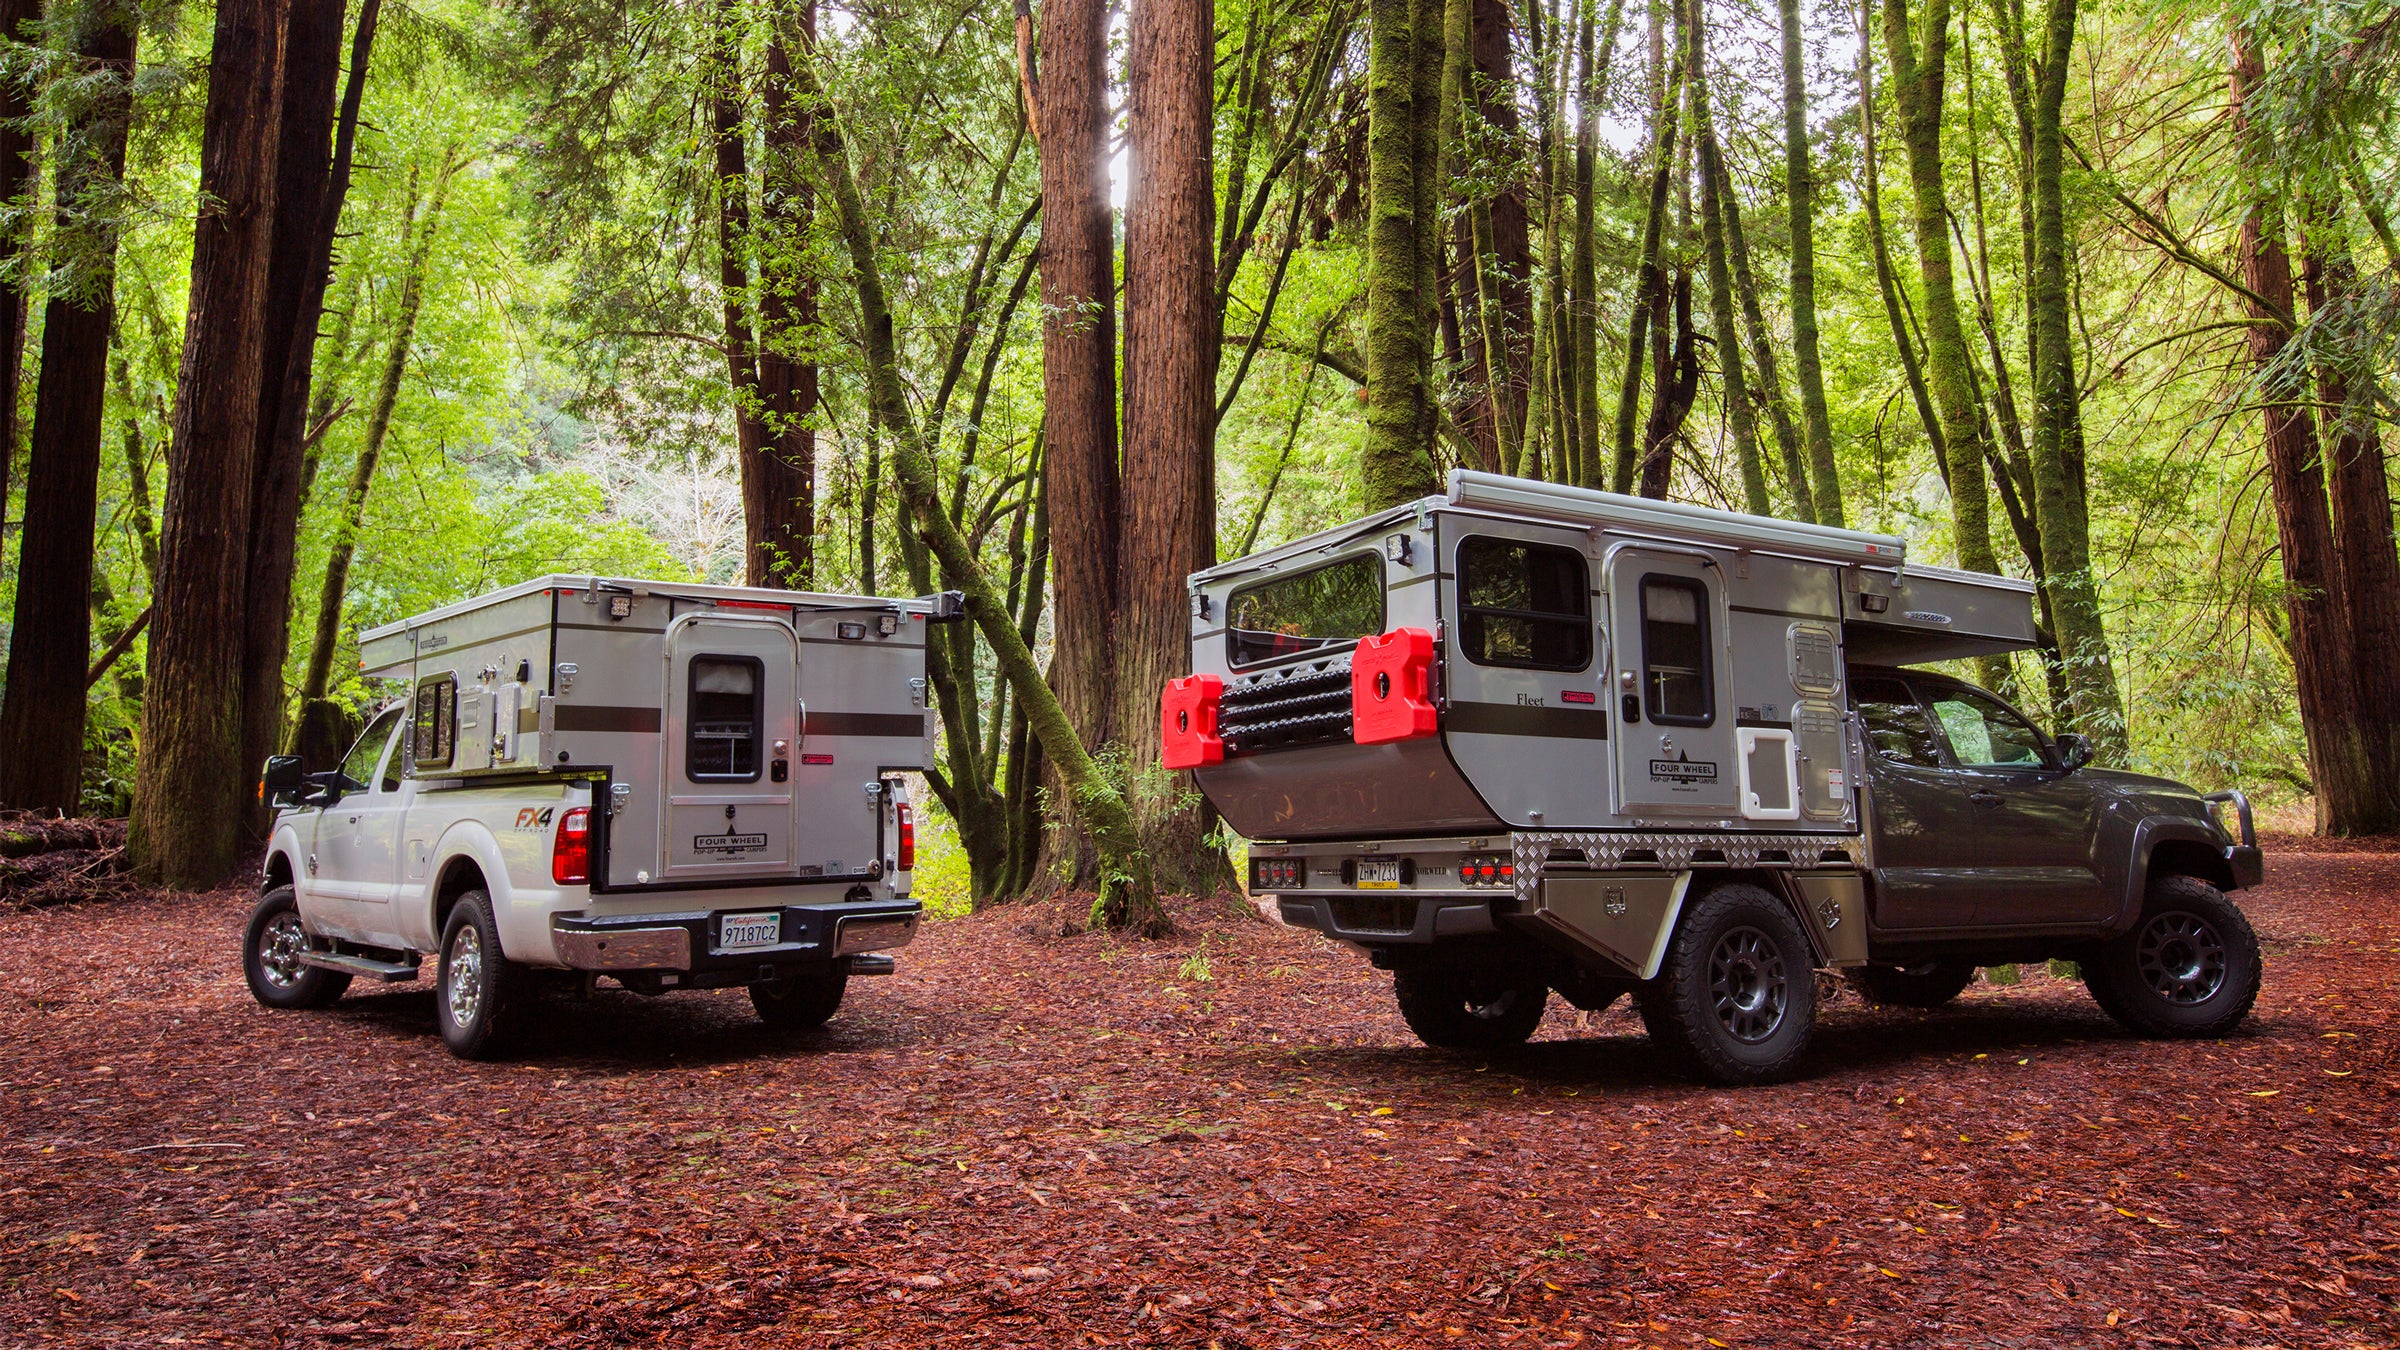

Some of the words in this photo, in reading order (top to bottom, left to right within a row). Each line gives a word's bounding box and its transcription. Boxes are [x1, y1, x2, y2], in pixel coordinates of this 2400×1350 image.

[1517, 693, 1545, 707] Fleet
[1654, 764, 1680, 773] FOUR
[1683, 766, 1712, 774] WHEEL
[514, 807, 555, 828] FX4
[699, 838, 727, 846] FOUR
[734, 916, 769, 926] California
[724, 925, 776, 944] 97187C2
